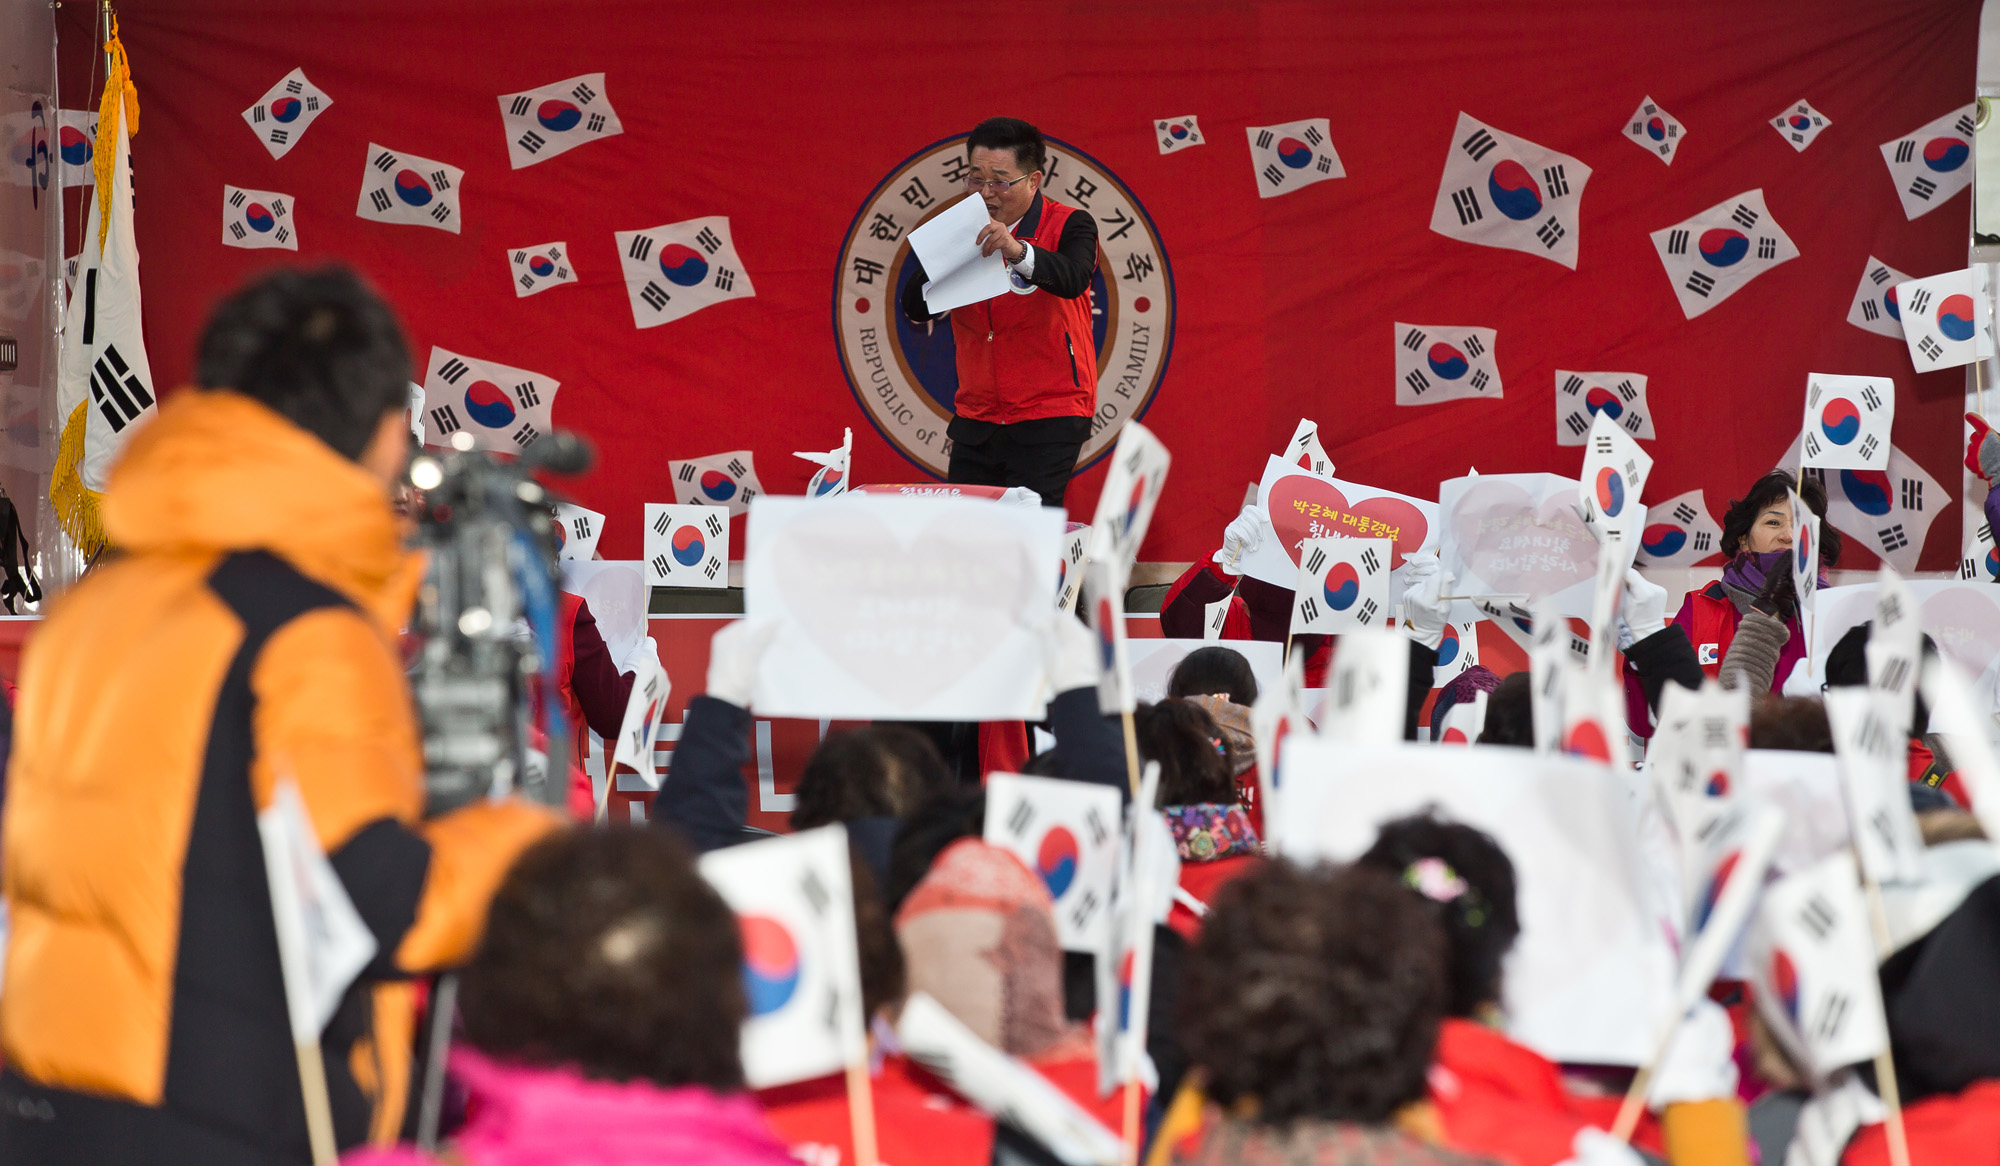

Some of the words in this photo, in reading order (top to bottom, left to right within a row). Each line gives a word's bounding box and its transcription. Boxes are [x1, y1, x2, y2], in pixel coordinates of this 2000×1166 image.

[853, 155, 971, 285] 대한민국
[1041, 155, 1154, 283] 사모가족
[860, 326, 914, 426] REPUBLIC
[916, 428, 938, 445] of
[1114, 321, 1150, 400] FAMILY
[1293, 499, 1338, 521] 박근혜
[1342, 513, 1400, 542] 대통령님
[1309, 520, 1358, 539] 힘내
